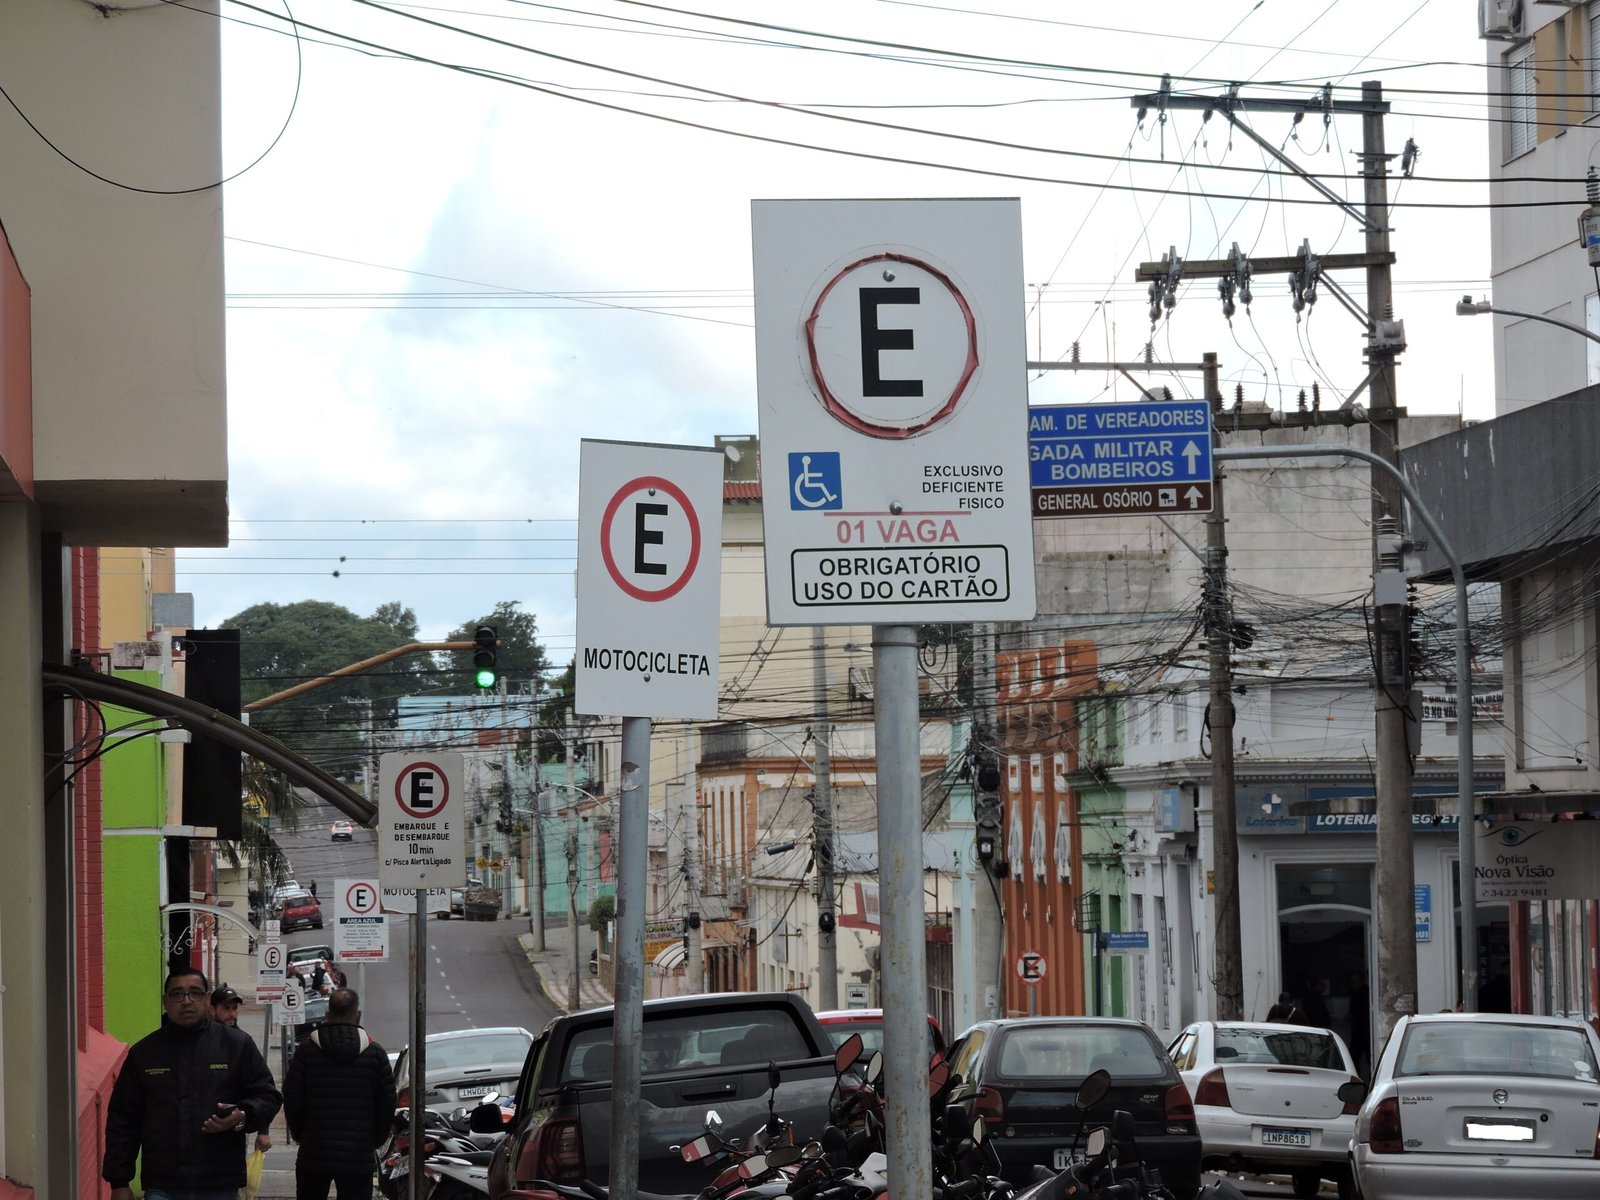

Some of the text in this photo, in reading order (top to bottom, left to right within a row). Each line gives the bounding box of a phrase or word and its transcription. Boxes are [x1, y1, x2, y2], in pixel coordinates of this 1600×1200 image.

[859, 287, 924, 398] E
[1030, 409, 1205, 431] AM. DE VEREADORES
[1030, 440, 1174, 461] GADA MILITAR
[924, 465, 1004, 477] EXCLUSIVO
[1051, 461, 1175, 481] BOMBEIROS
[922, 481, 1004, 493] DEFICIENTE
[959, 497, 1004, 509] FISICO
[1038, 488, 1153, 510] GENERAL OSÓRIO
[634, 502, 669, 576] E
[836, 519, 961, 544] 01 VAGA
[819, 551, 981, 577] OBRIGATÓRIO
[804, 575, 998, 601] USO DO CARTÃO
[584, 647, 711, 676] MOTOCICLETA
[410, 771, 434, 809] E
[394, 822, 450, 831] EMBARQUE E
[1246, 815, 1298, 827] Loterias
[394, 832, 451, 842] DESEMBARQUE
[408, 843, 434, 854] 10 min
[393, 858, 409, 866] Pisca
[430, 857, 452, 867] Ligado
[1474, 864, 1555, 878] Nova Visão
[356, 889, 367, 908] E
[383, 887, 447, 896] MOTOCETA
[270, 951, 277, 964] E
[1023, 956, 1040, 979] E
[286, 994, 297, 1007] E
[1267, 1133, 1306, 1145] INP8G18
